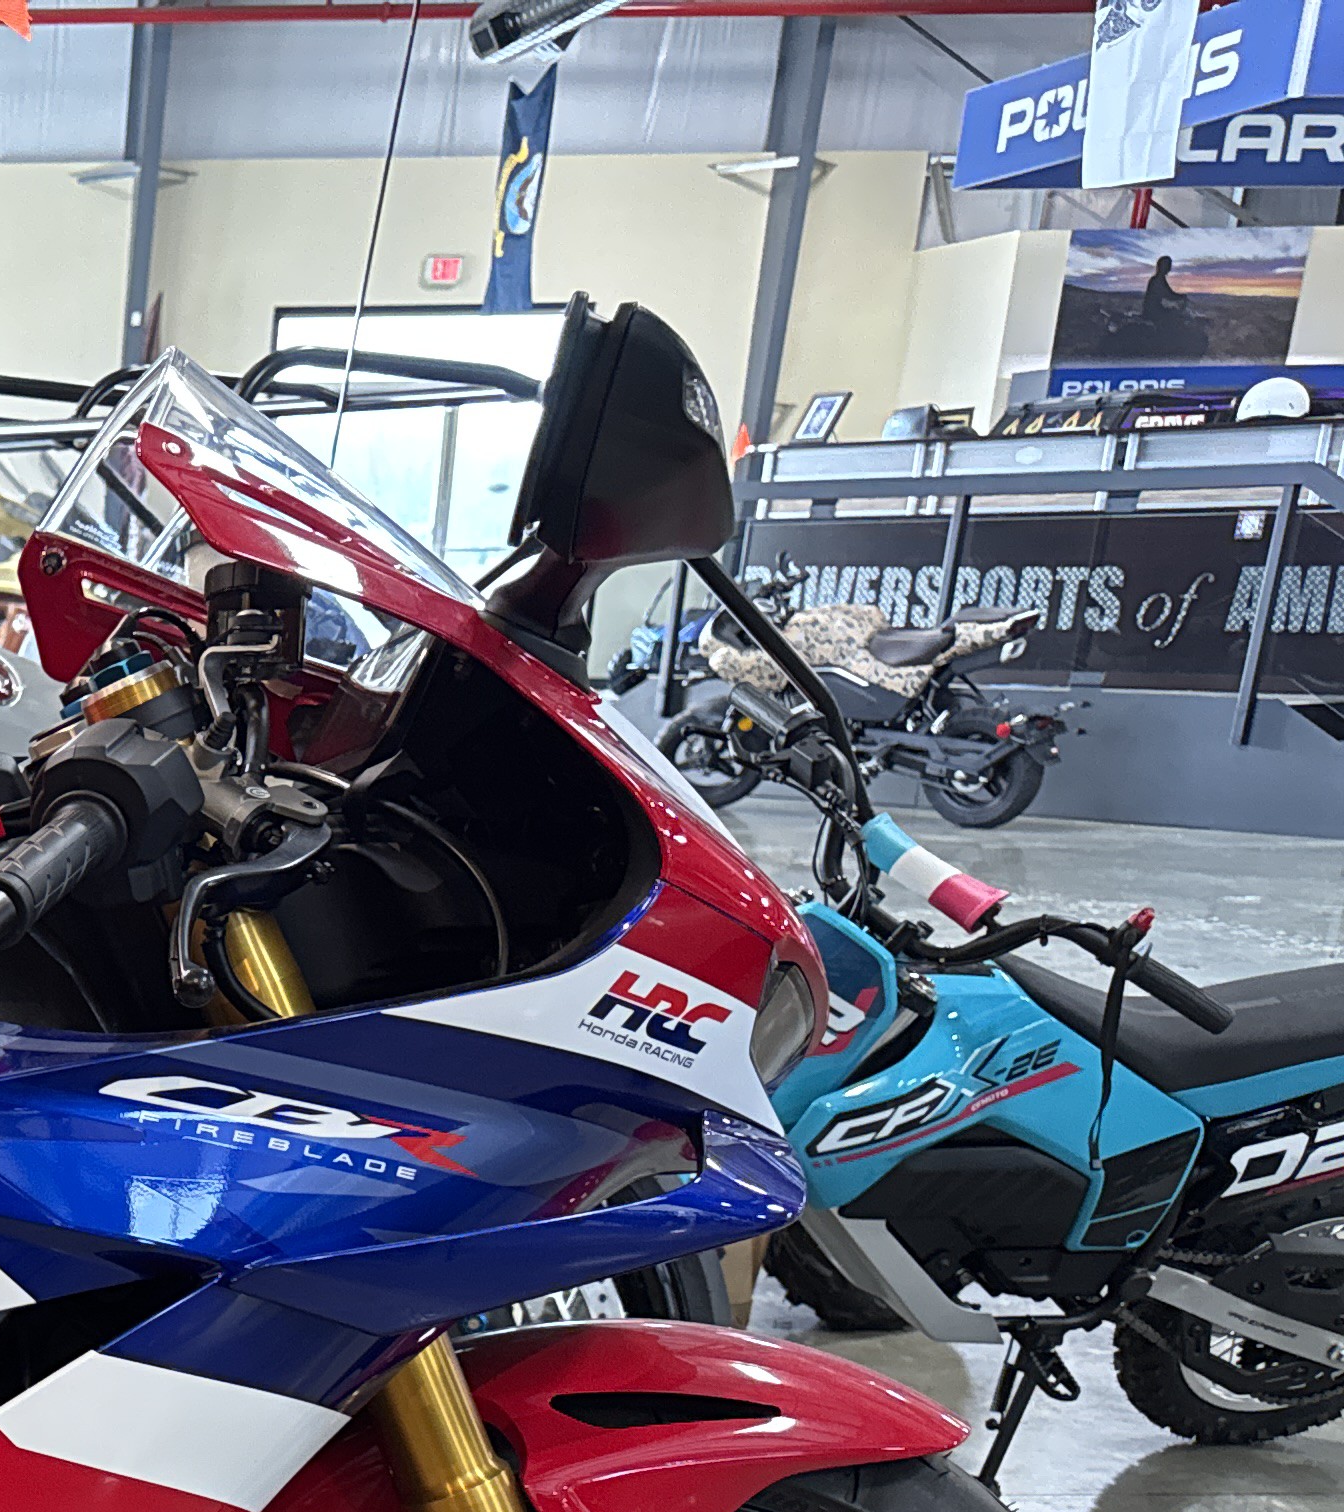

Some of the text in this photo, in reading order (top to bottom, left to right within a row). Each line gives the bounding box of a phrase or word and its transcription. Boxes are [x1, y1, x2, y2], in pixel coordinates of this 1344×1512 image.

[743, 565, 1126, 634] PWERSPORTS
[1136, 571, 1215, 649] of
[577, 1018, 695, 1069] Honda RACING
[587, 970, 733, 1055] HRC
[138, 1110, 417, 1181] FIREBLADE
